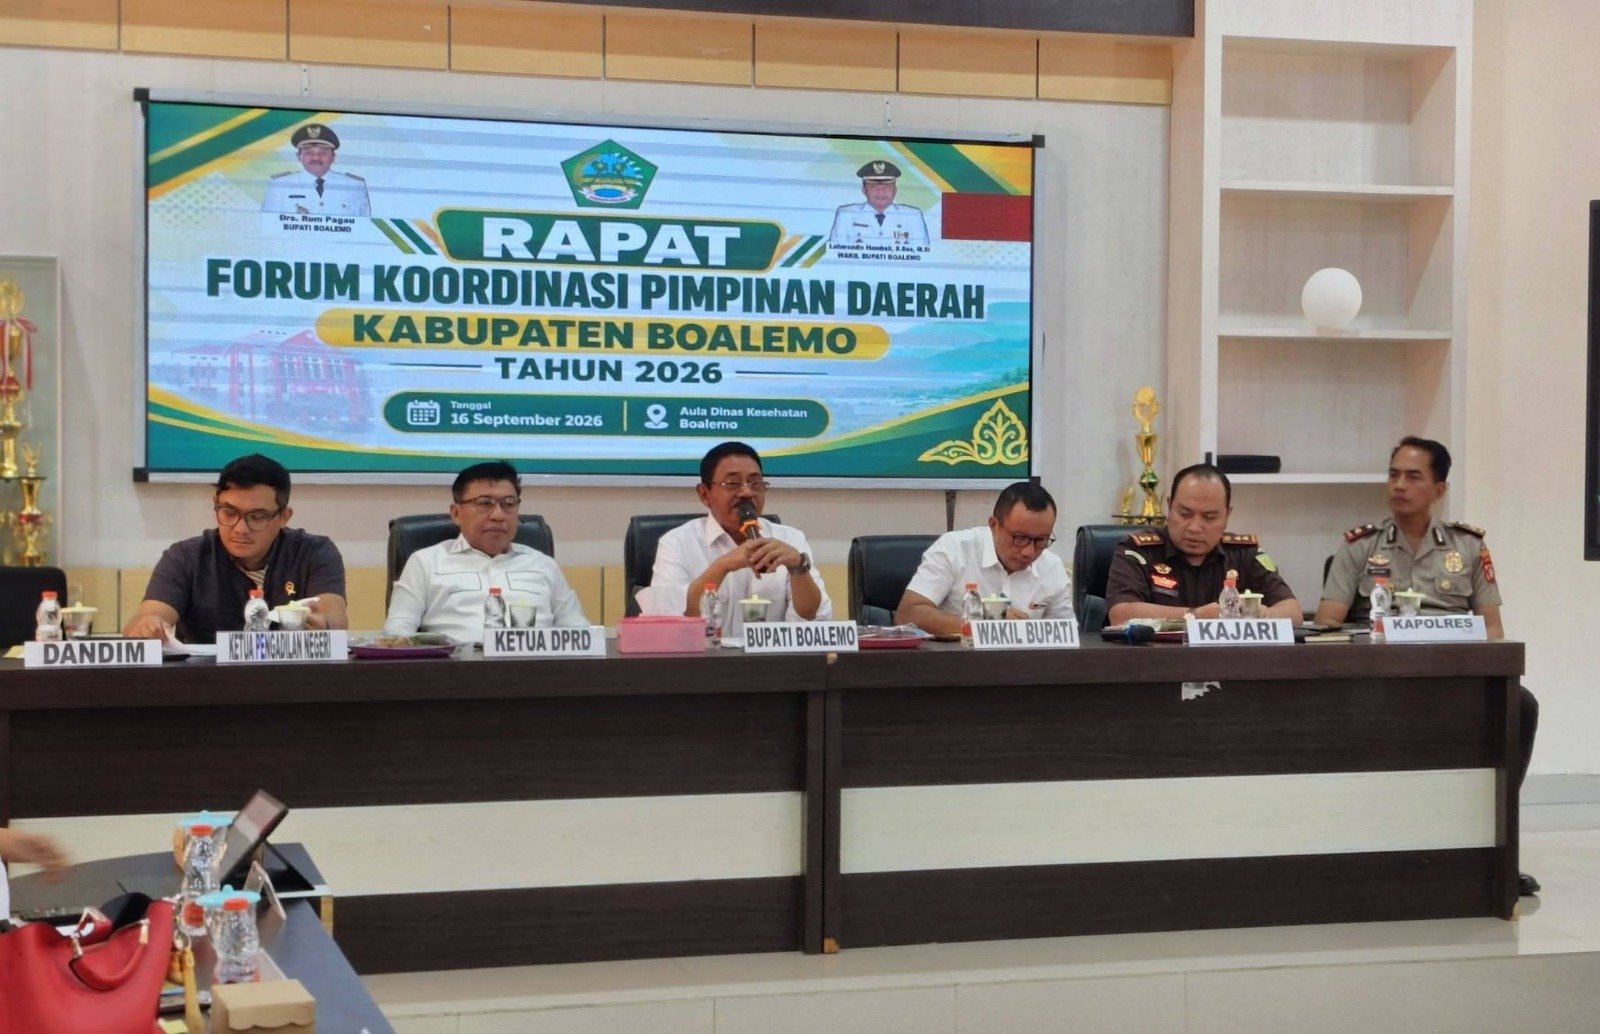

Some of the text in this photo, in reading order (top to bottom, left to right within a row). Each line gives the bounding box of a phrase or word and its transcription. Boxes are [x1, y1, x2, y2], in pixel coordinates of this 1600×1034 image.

[482, 217, 741, 266] RAPAT
[837, 252, 860, 260] WAKIL
[206, 258, 985, 319] FORUM KOORDINASI PIMPINAN DAERAH
[353, 314, 857, 354] KABUPATEN BOALEMO
[494, 357, 723, 383] TAHUN 2026
[450, 401, 492, 410] Tanggal
[679, 406, 808, 418] Aula Dinas Kesehatan
[450, 413, 603, 427] 16 September 2026
[679, 419, 738, 430] Boalemo
[977, 620, 1074, 645] WAKIL BUPATI
[1199, 621, 1279, 641] KAJARI
[1393, 618, 1474, 630] KAPOLRES
[229, 632, 331, 659] KETUA PENGADILAN NEGERI
[494, 628, 592, 651] KETUA DPRD
[746, 625, 855, 648] BUPATI BOALEMO
[43, 642, 145, 665] DANDIM
